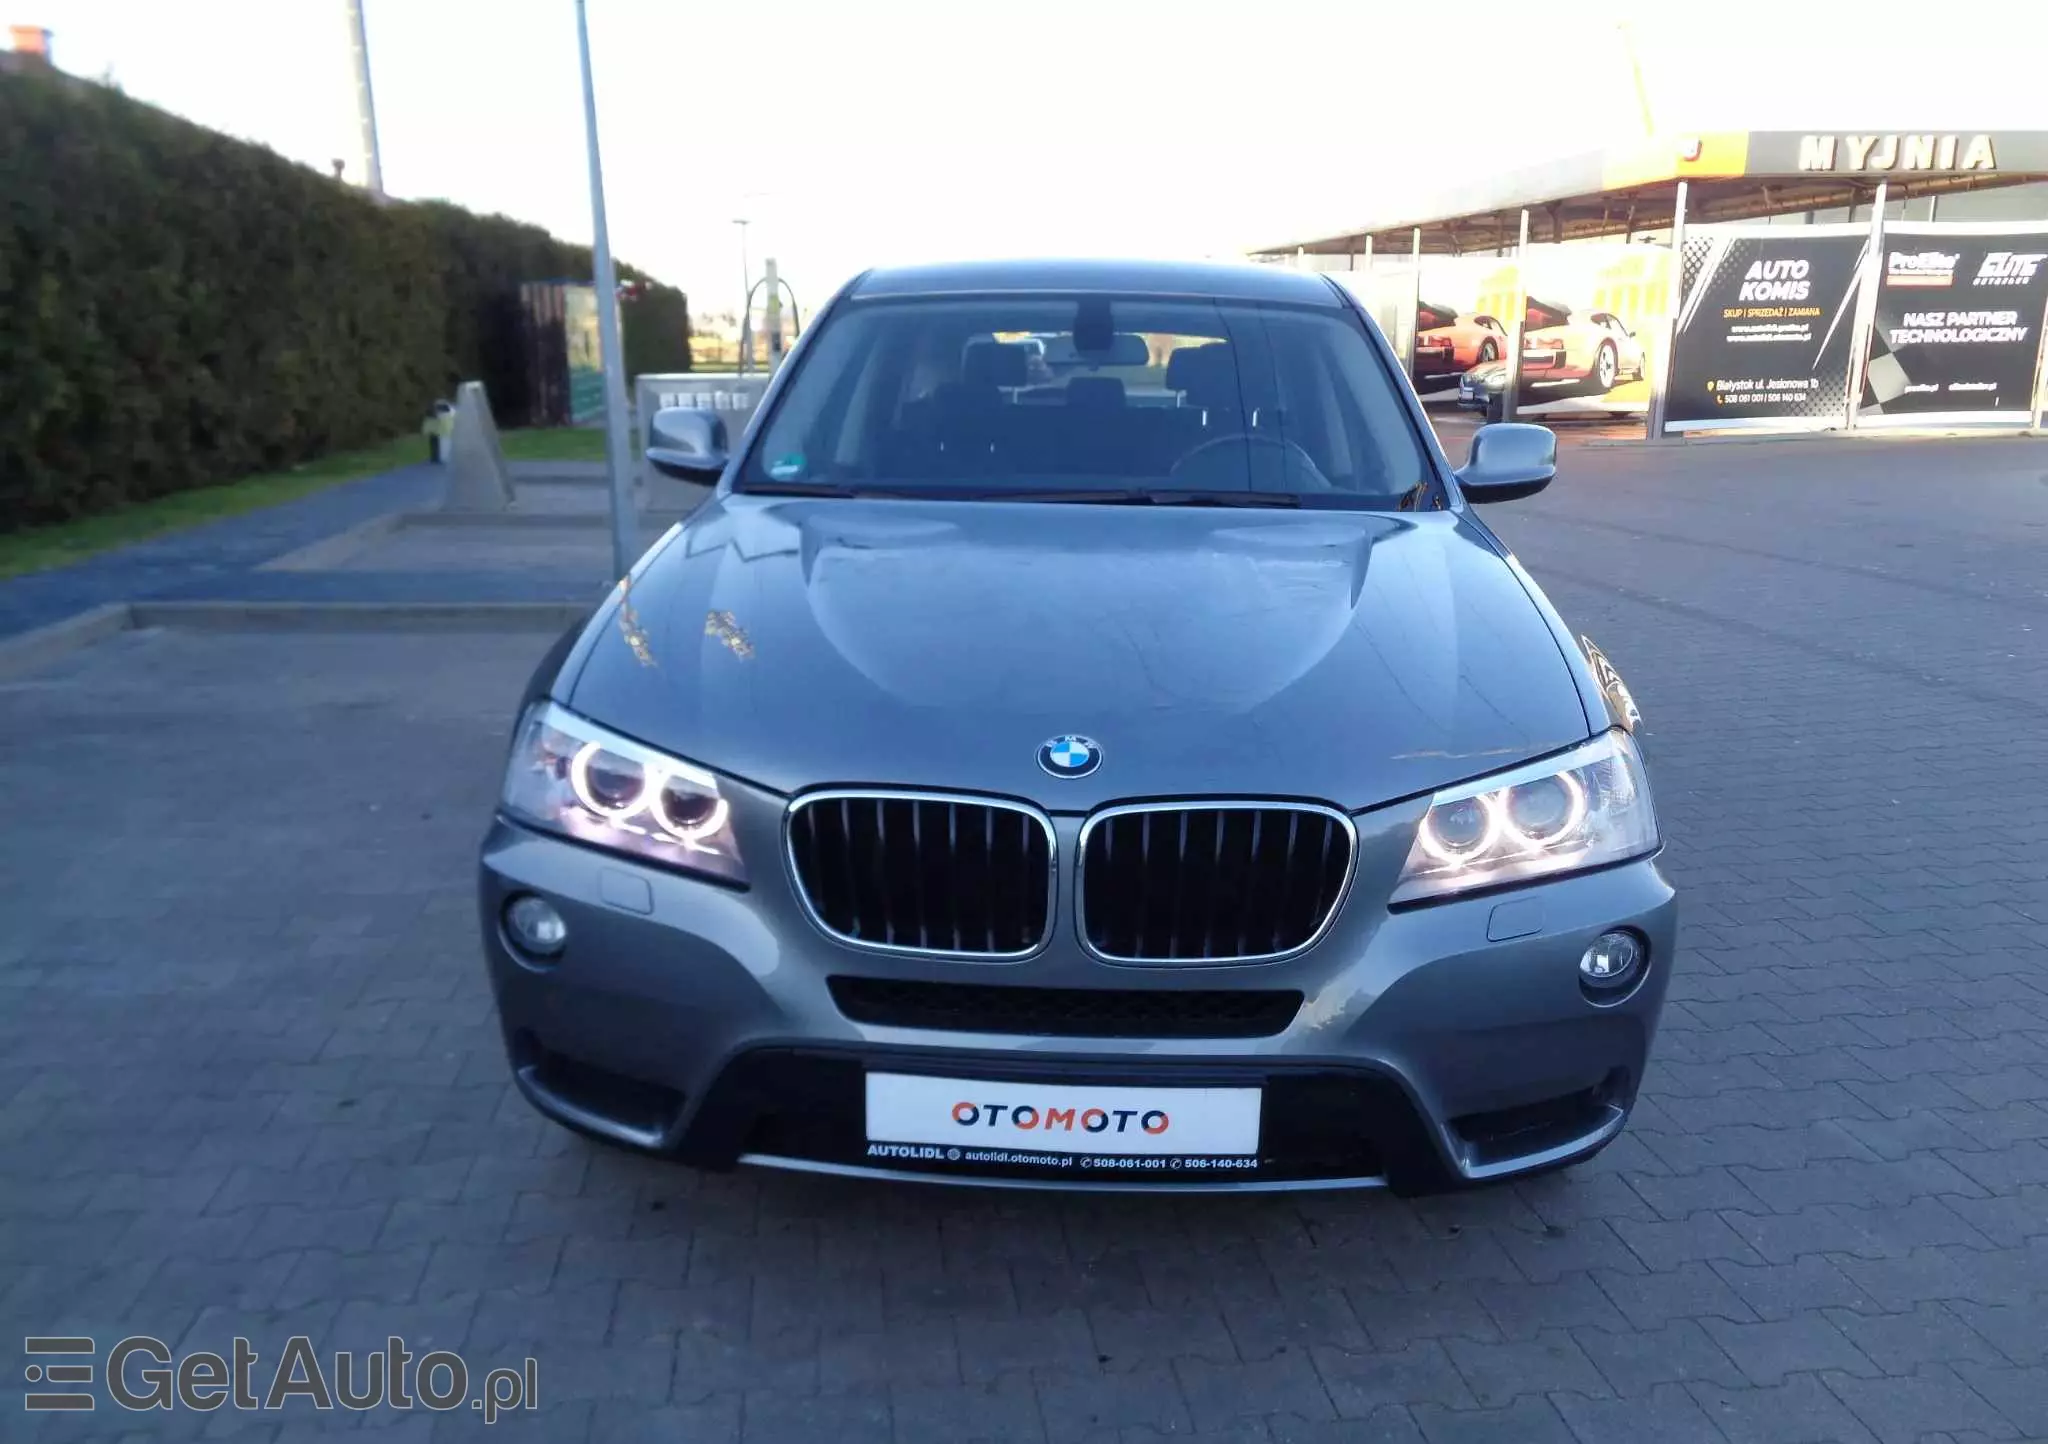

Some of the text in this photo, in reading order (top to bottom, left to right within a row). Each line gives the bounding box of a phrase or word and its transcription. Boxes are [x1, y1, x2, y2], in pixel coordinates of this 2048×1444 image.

[1798, 134, 1998, 170] MYJNIA
[1745, 260, 1809, 280] AUTO
[1738, 281, 1811, 301] KOMIS
[1724, 309, 1743, 318] SKUP
[1903, 311, 2018, 327] NASZ PARTNER
[1889, 327, 2029, 344] TECHNOLOGICZNY
[951, 1101, 1169, 1135] OTOMOTO
[867, 1144, 945, 1160] AUTOLIDL
[964, 1151, 1073, 1168] autolidl.otomoto.pl
[1093, 1158, 1166, 1168] 508-061-001
